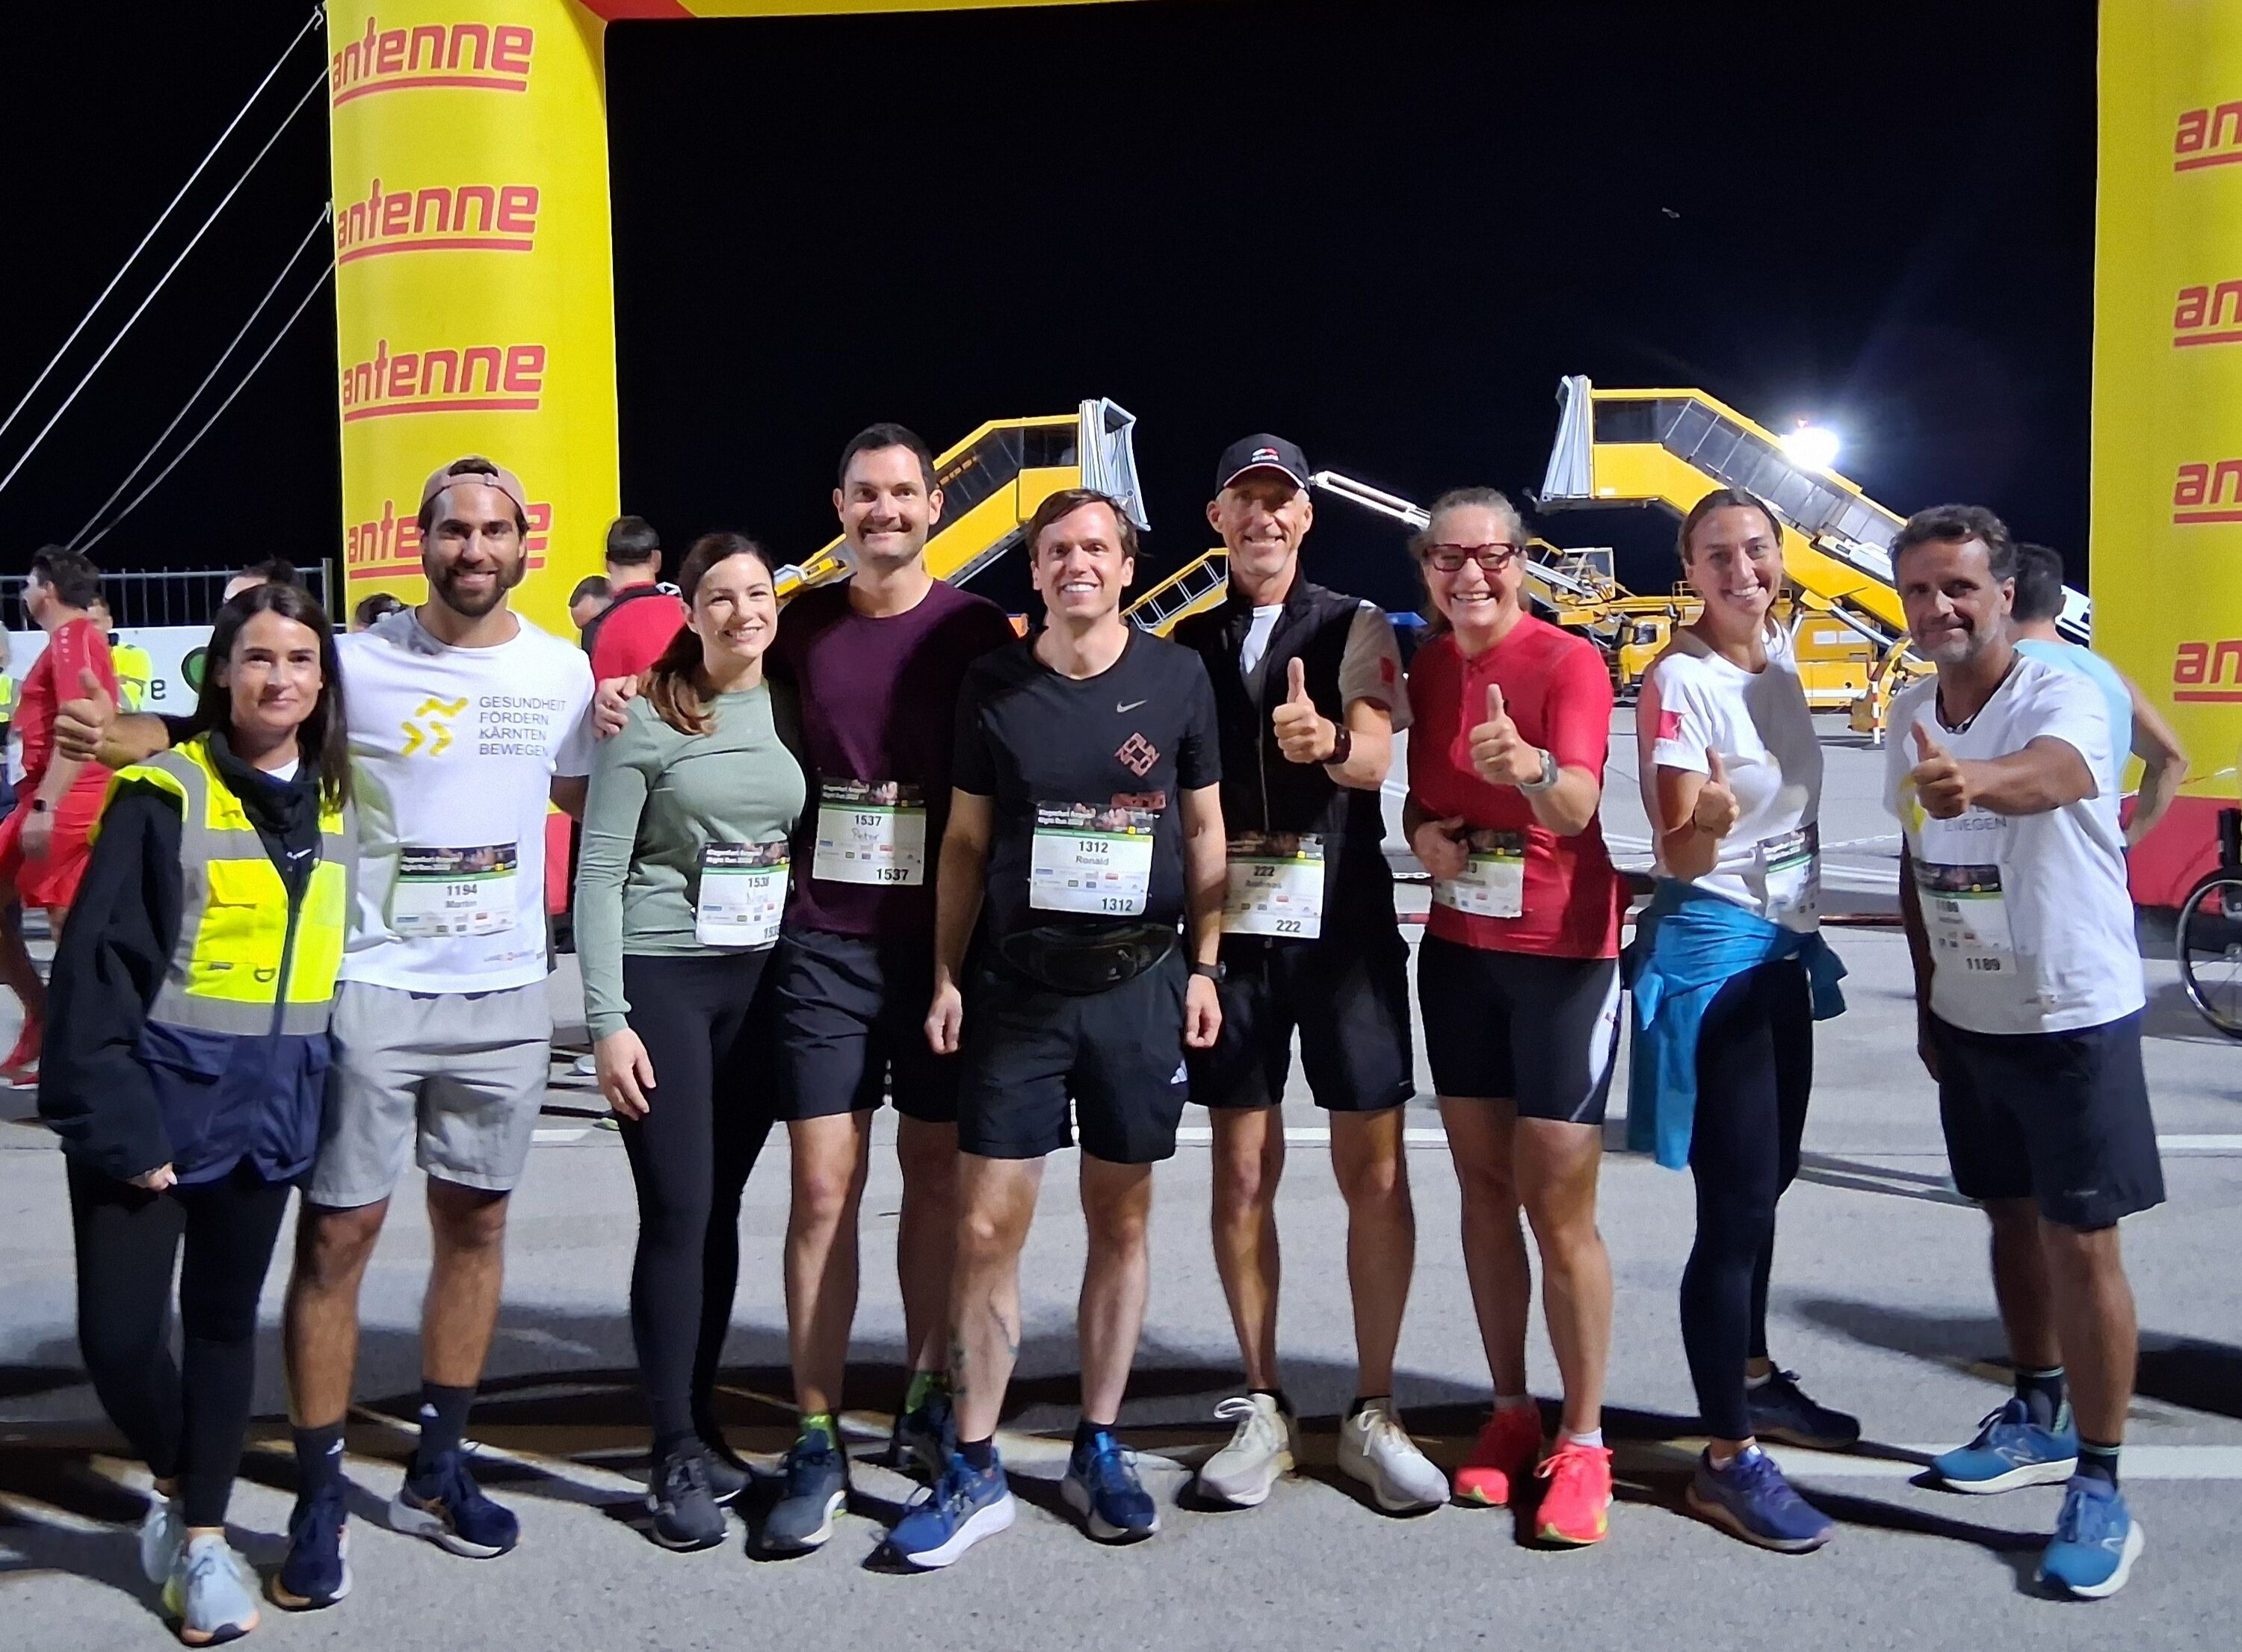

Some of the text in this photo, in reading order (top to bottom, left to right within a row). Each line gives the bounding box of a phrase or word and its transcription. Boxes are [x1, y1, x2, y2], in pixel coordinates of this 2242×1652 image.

[333, 16, 534, 93] antenne
[338, 178, 540, 249] antenne
[343, 339, 546, 406] antenne
[348, 500, 552, 563] antee
[479, 696, 566, 711] GESUNDHEIT
[854, 814, 882, 826] 1537
[1078, 841, 1108, 853] 1312
[1075, 856, 1109, 866] Ronald
[876, 868, 909, 881] 1537
[1254, 865, 1275, 876] 222
[447, 884, 478, 896] 1194
[1102, 897, 1133, 912] 1312
[1276, 919, 1301, 933] 222
